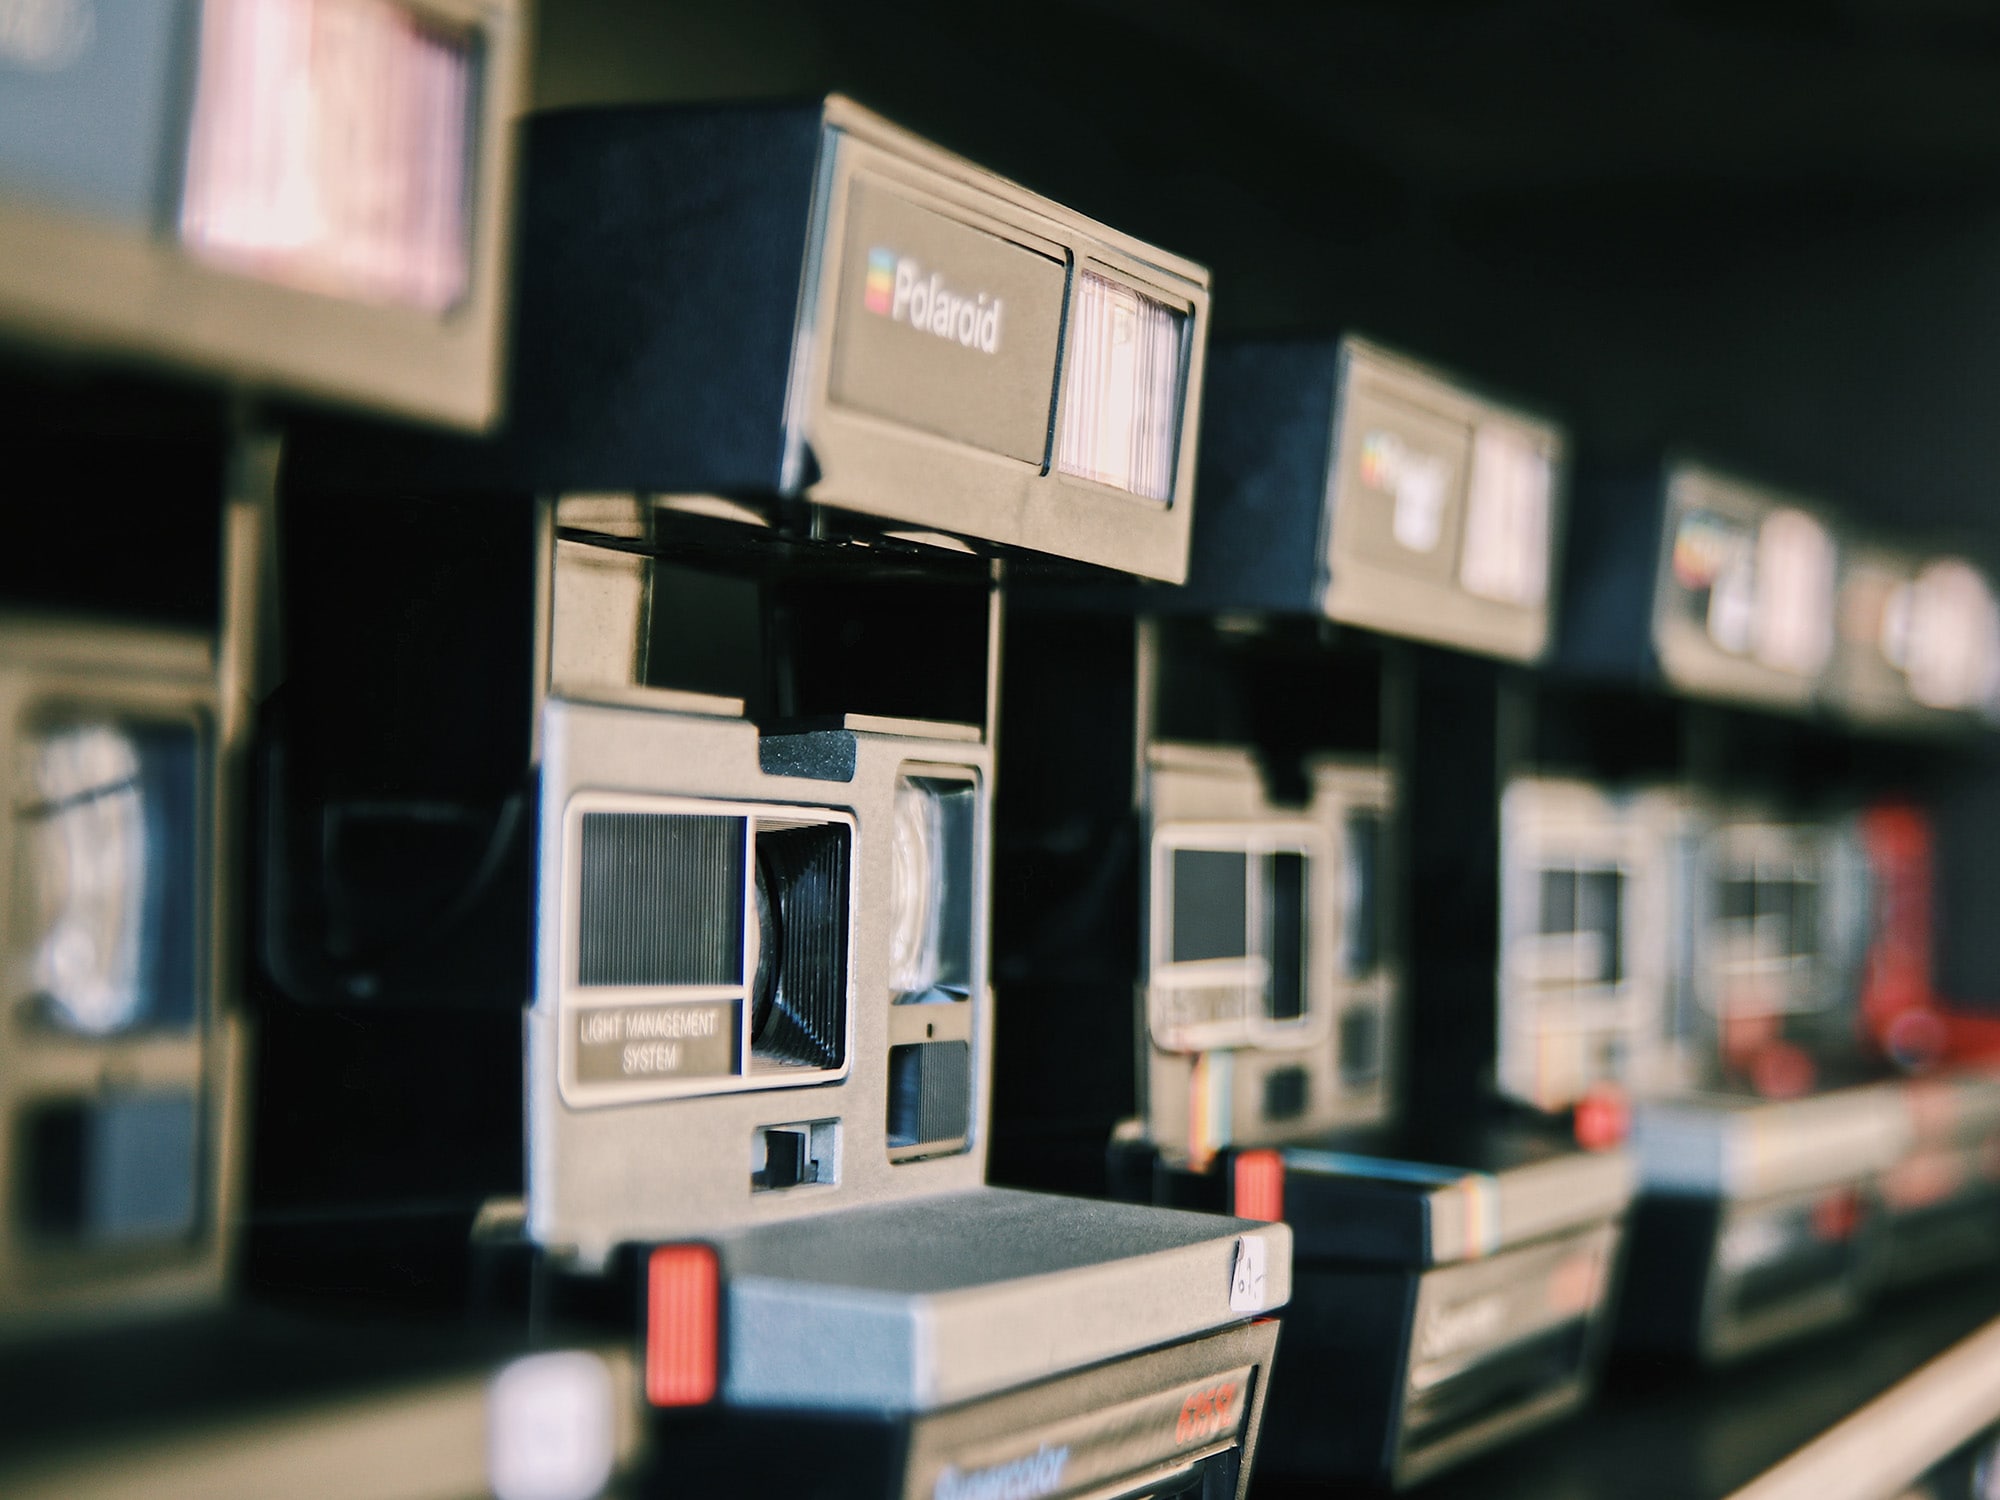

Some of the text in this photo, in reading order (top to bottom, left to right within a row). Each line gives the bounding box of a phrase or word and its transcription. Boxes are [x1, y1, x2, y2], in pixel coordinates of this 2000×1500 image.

[891, 256, 1003, 354] Polaroid
[580, 1009, 718, 1044] LIGHT MANAGEMENT
[622, 1043, 679, 1074] SYSTEM
